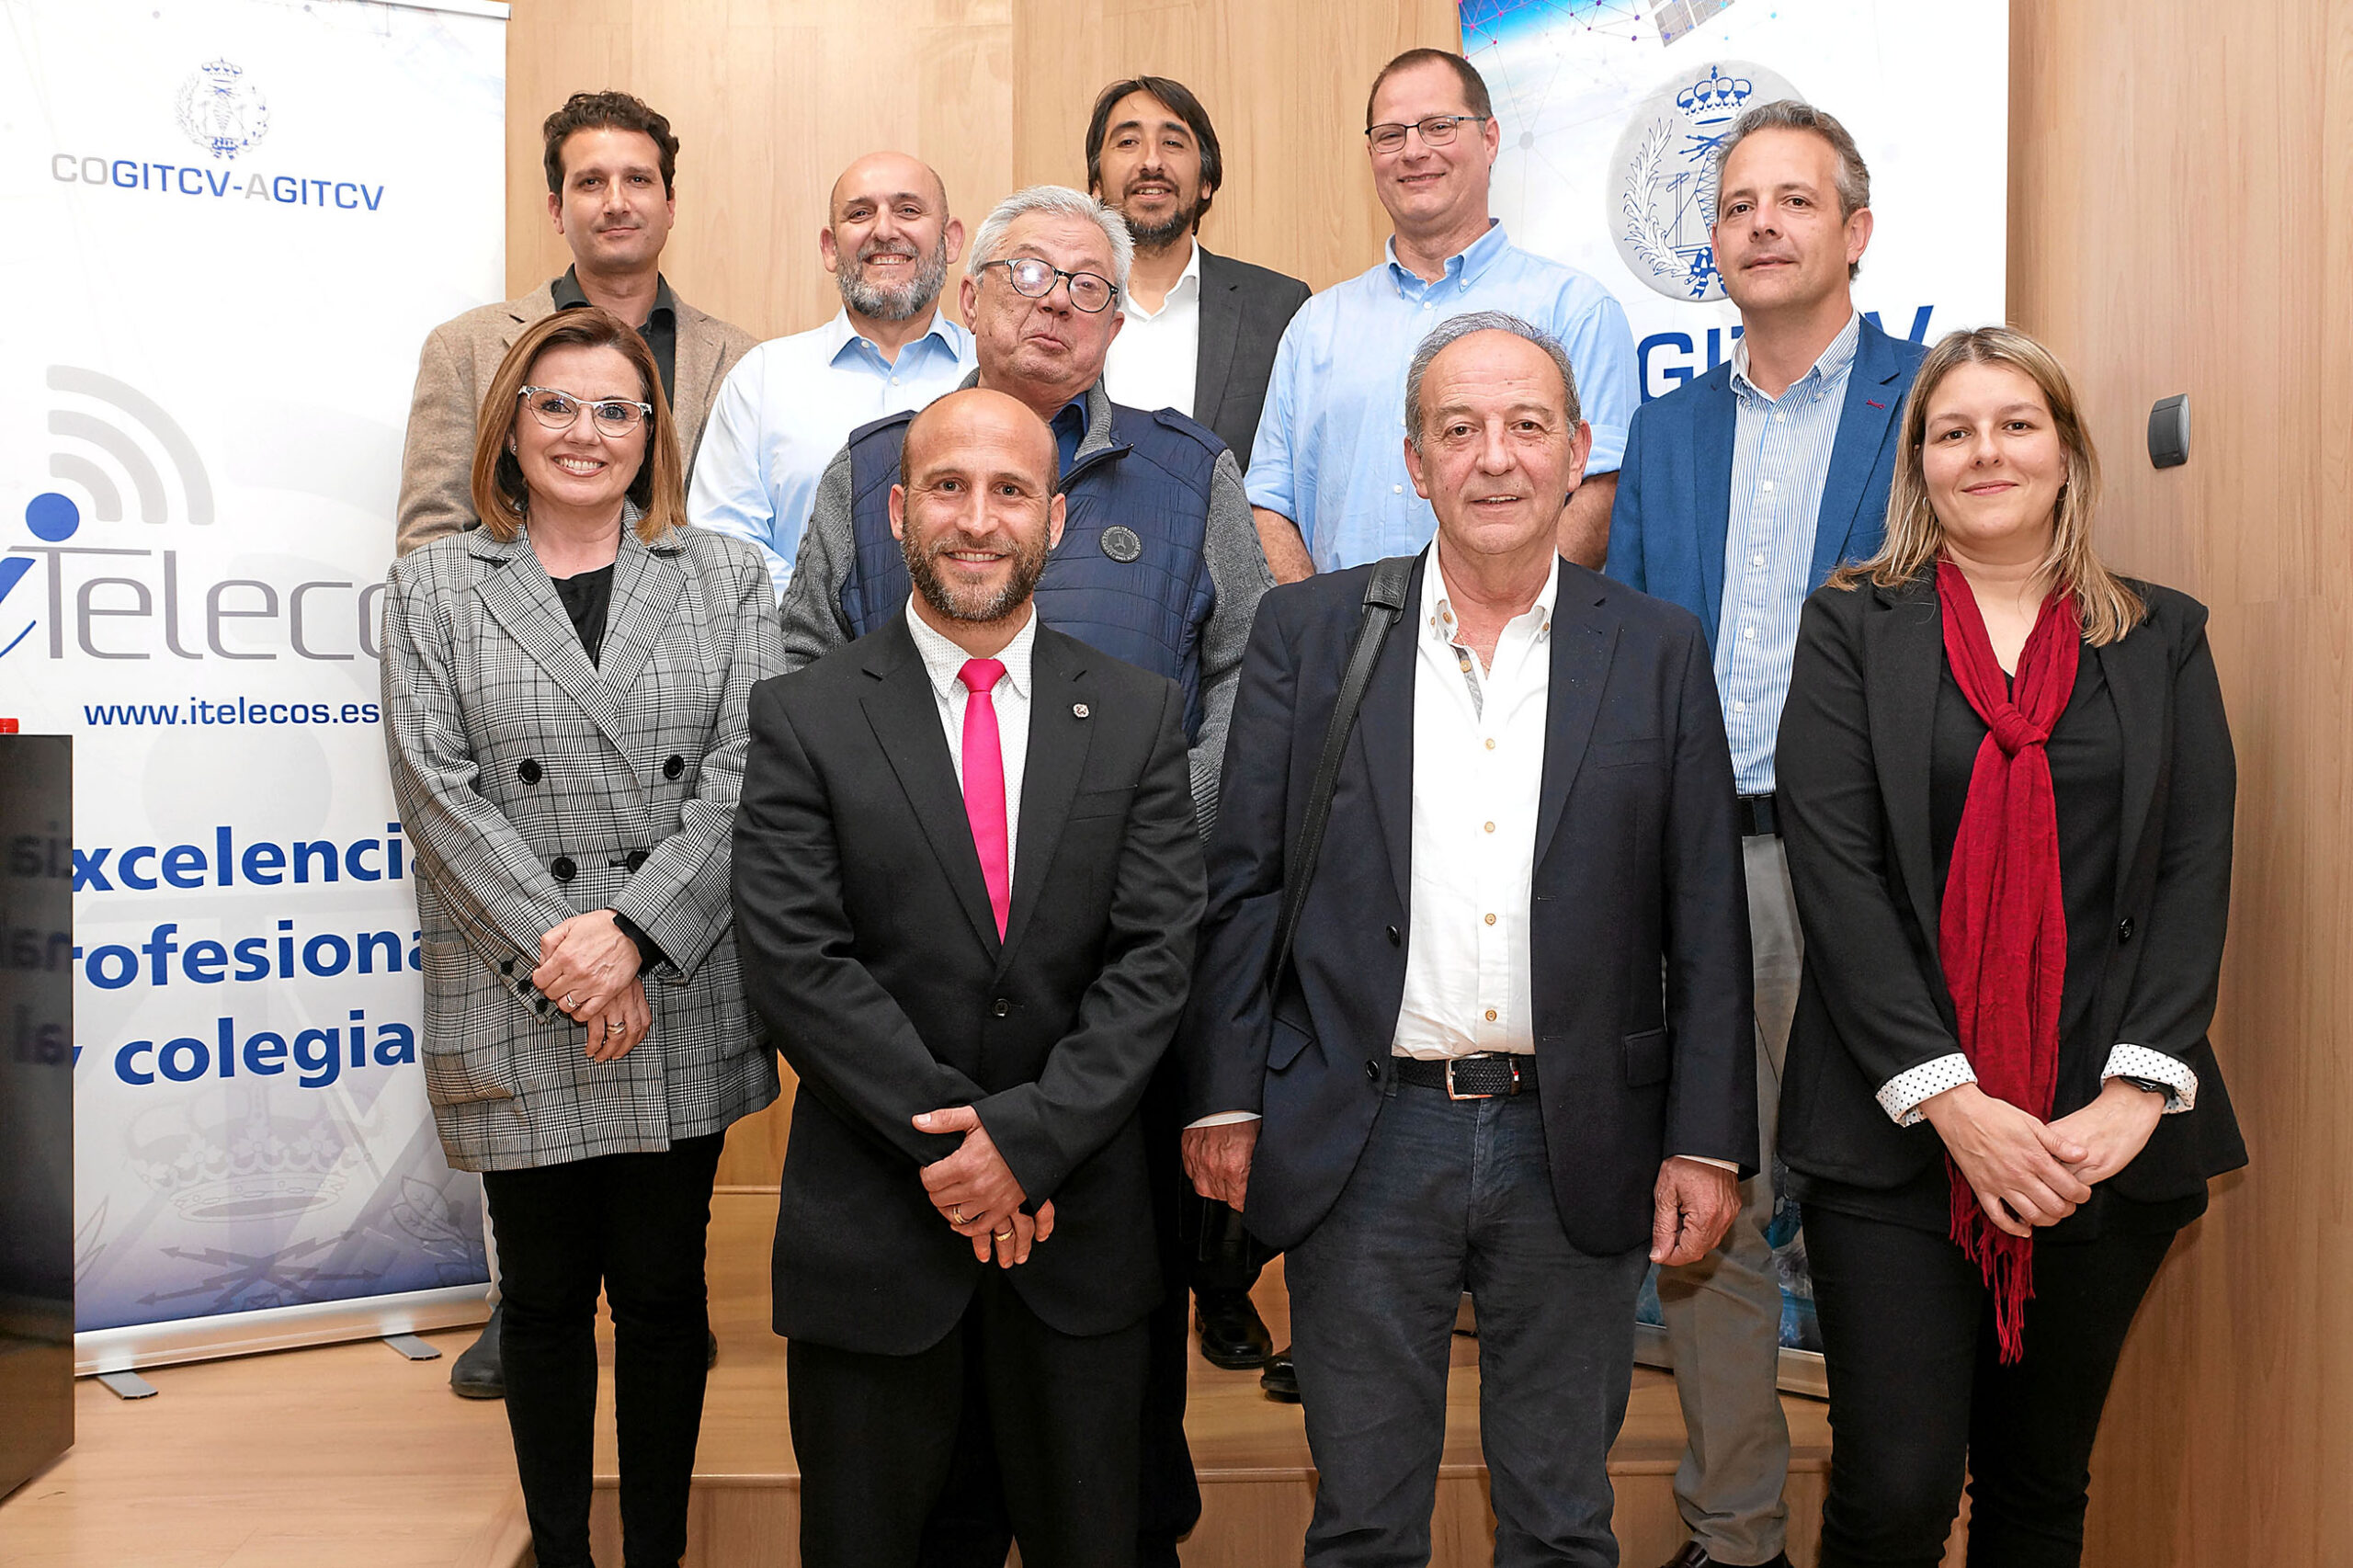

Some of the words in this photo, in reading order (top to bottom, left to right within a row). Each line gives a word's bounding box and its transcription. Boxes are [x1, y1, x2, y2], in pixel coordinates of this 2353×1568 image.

[51, 153, 384, 211] COGITCV-AGITCV
[84, 696, 380, 726] www.itelecos.es
[74, 822, 416, 892] xcelenci
